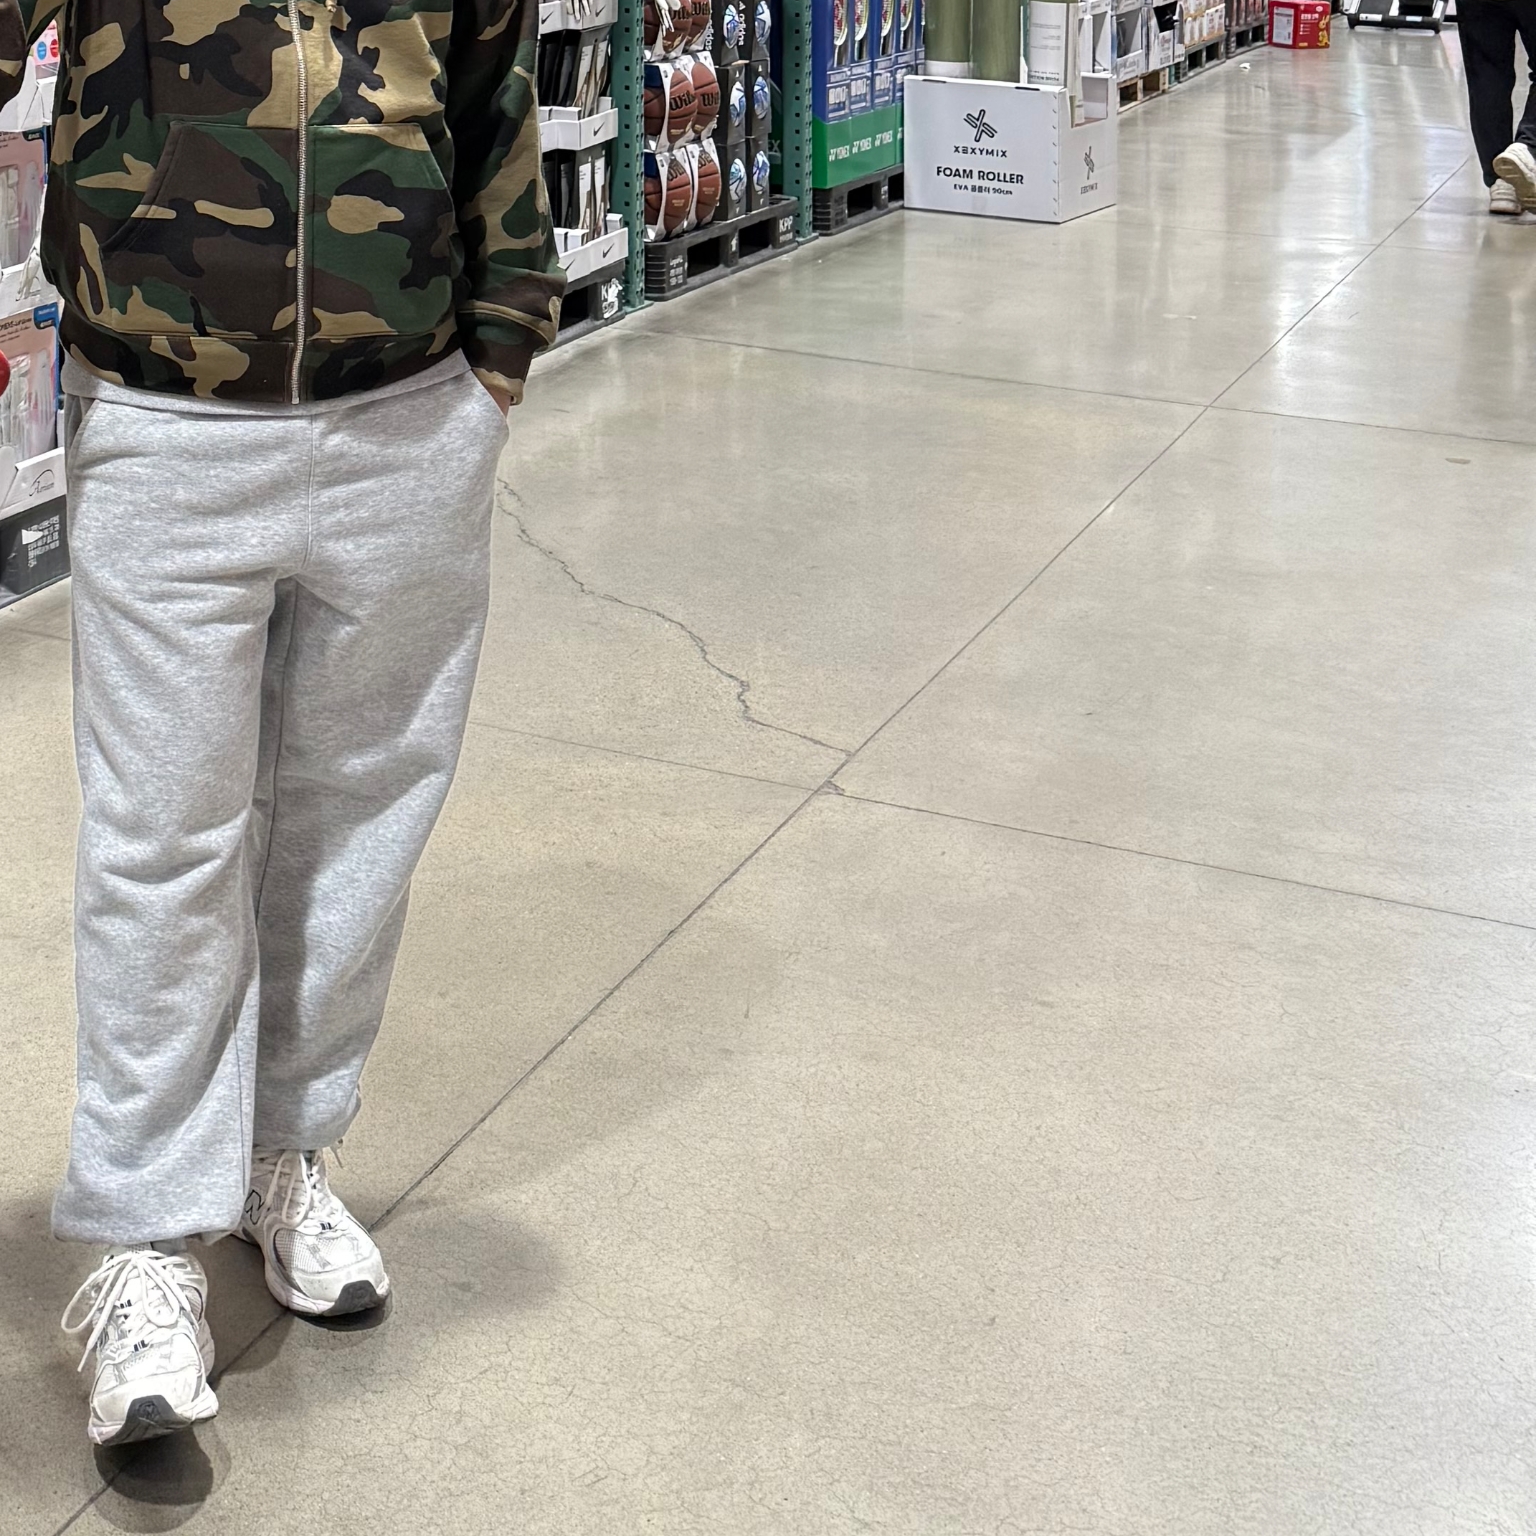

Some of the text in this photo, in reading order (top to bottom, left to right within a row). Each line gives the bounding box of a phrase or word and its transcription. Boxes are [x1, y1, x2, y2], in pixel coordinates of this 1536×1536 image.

[936, 166, 1025, 184] FOAM ROLLER
[953, 183, 968, 192] EVA
[778, 215, 793, 233] KPP
